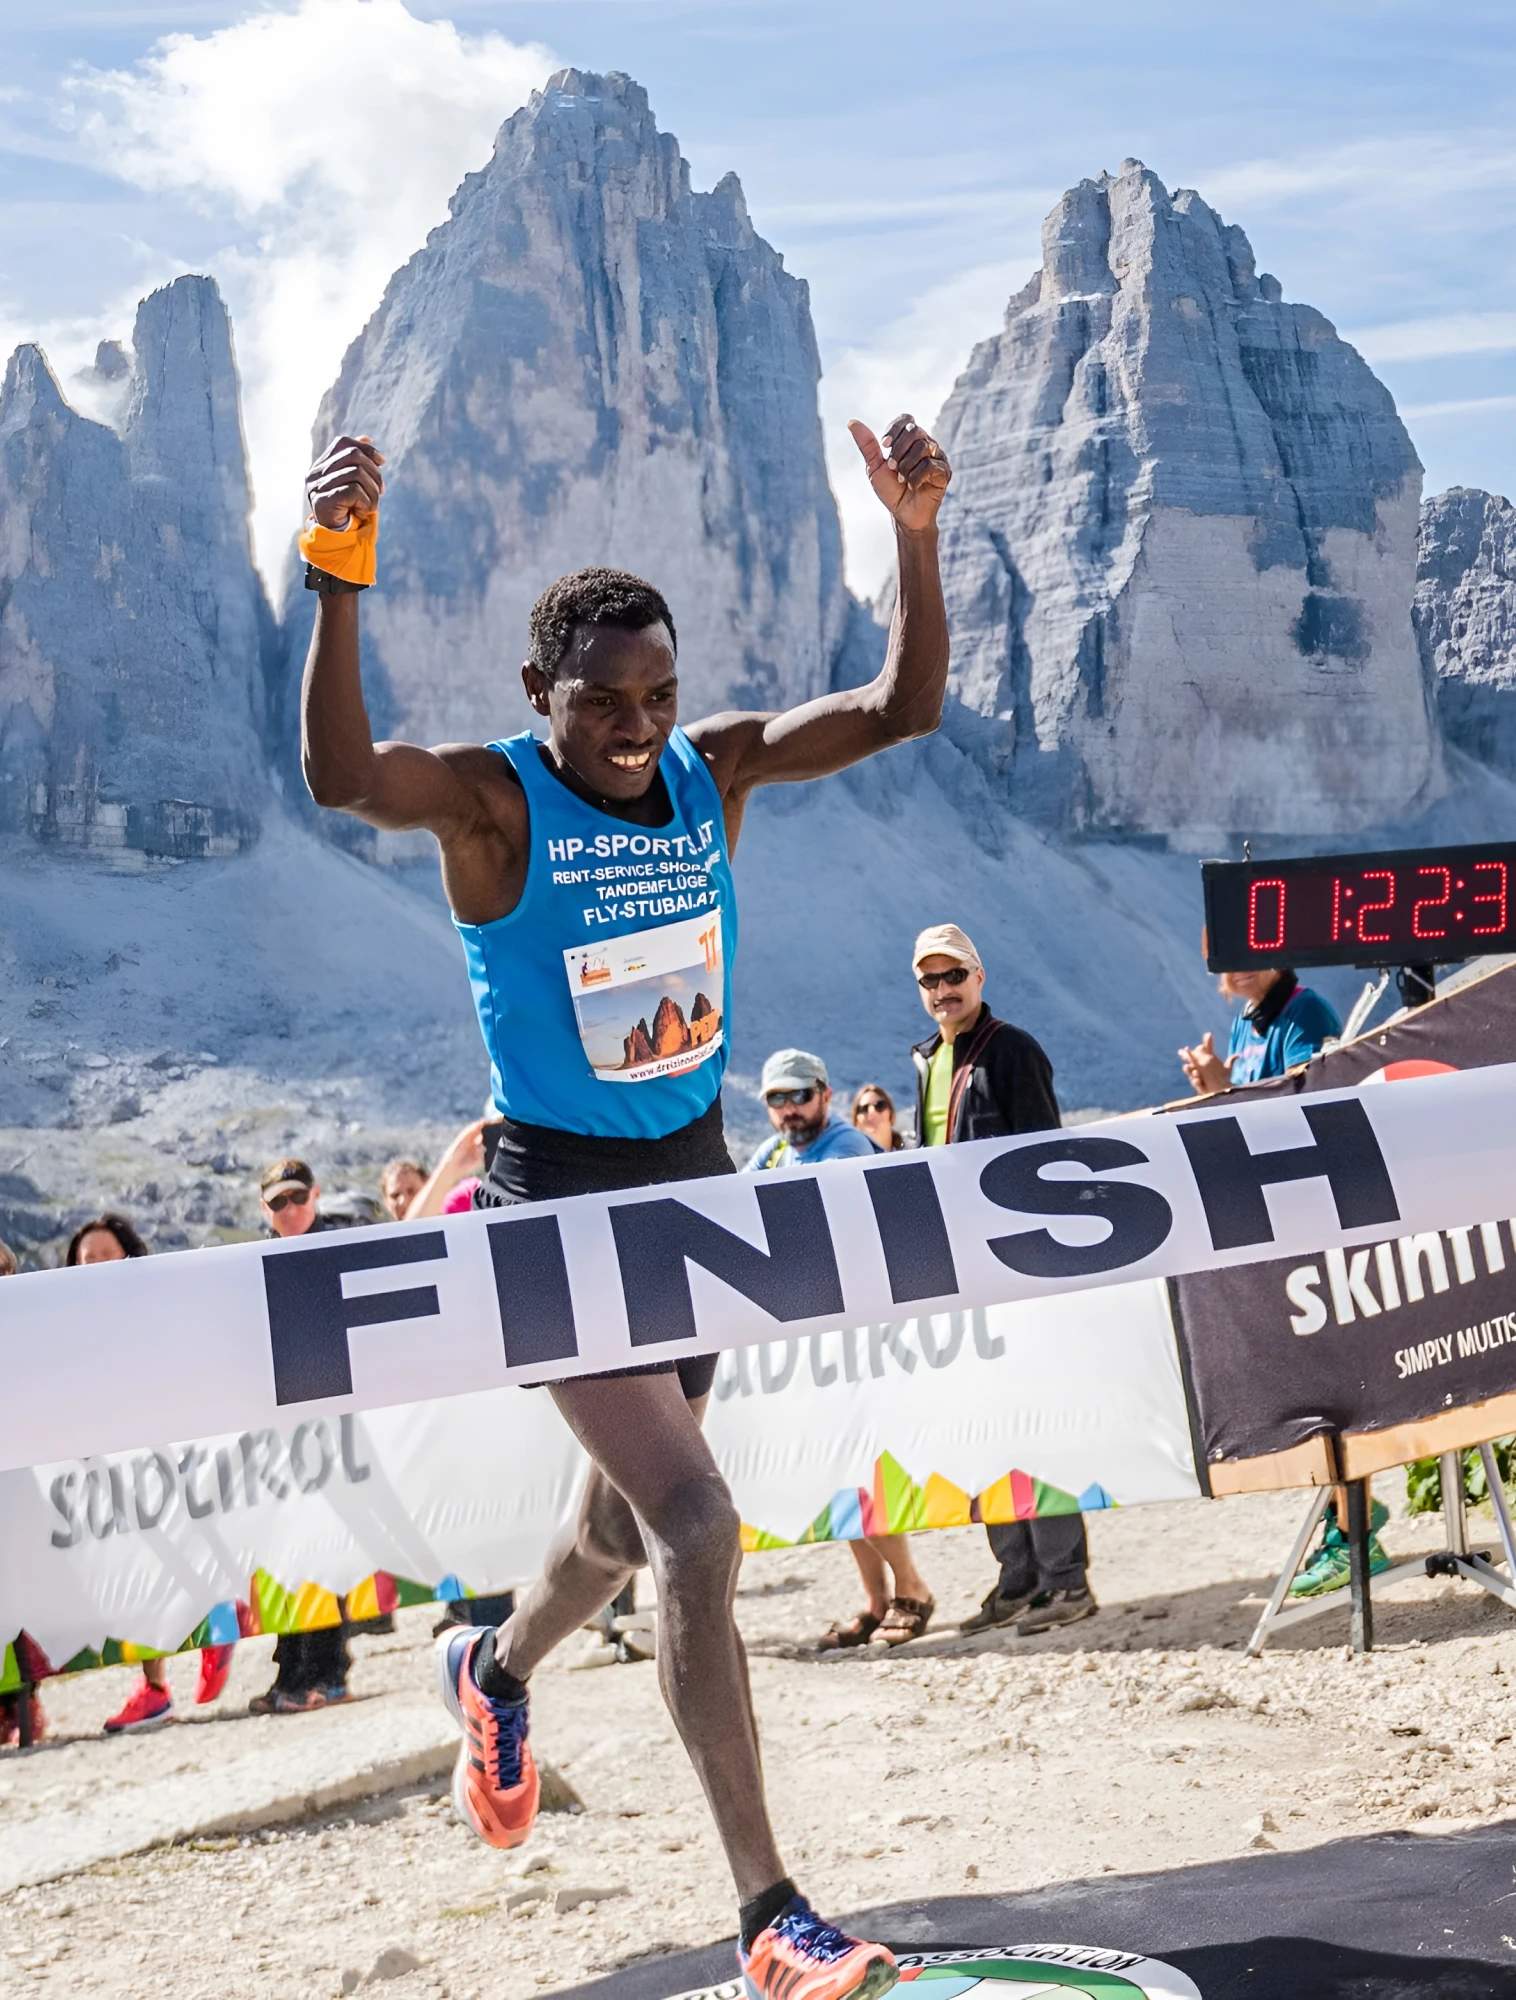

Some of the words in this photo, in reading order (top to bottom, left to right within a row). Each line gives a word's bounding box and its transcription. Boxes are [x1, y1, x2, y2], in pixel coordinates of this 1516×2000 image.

[583, 890, 719, 926] FLY-STUBAI.AT
[263, 1097, 1401, 1405] FINISH
[1395, 1333, 1452, 1379] SIMPLY
[1457, 1312, 1516, 1358] MULTIS
[898, 1946, 1147, 1971] ASSOCIATION
